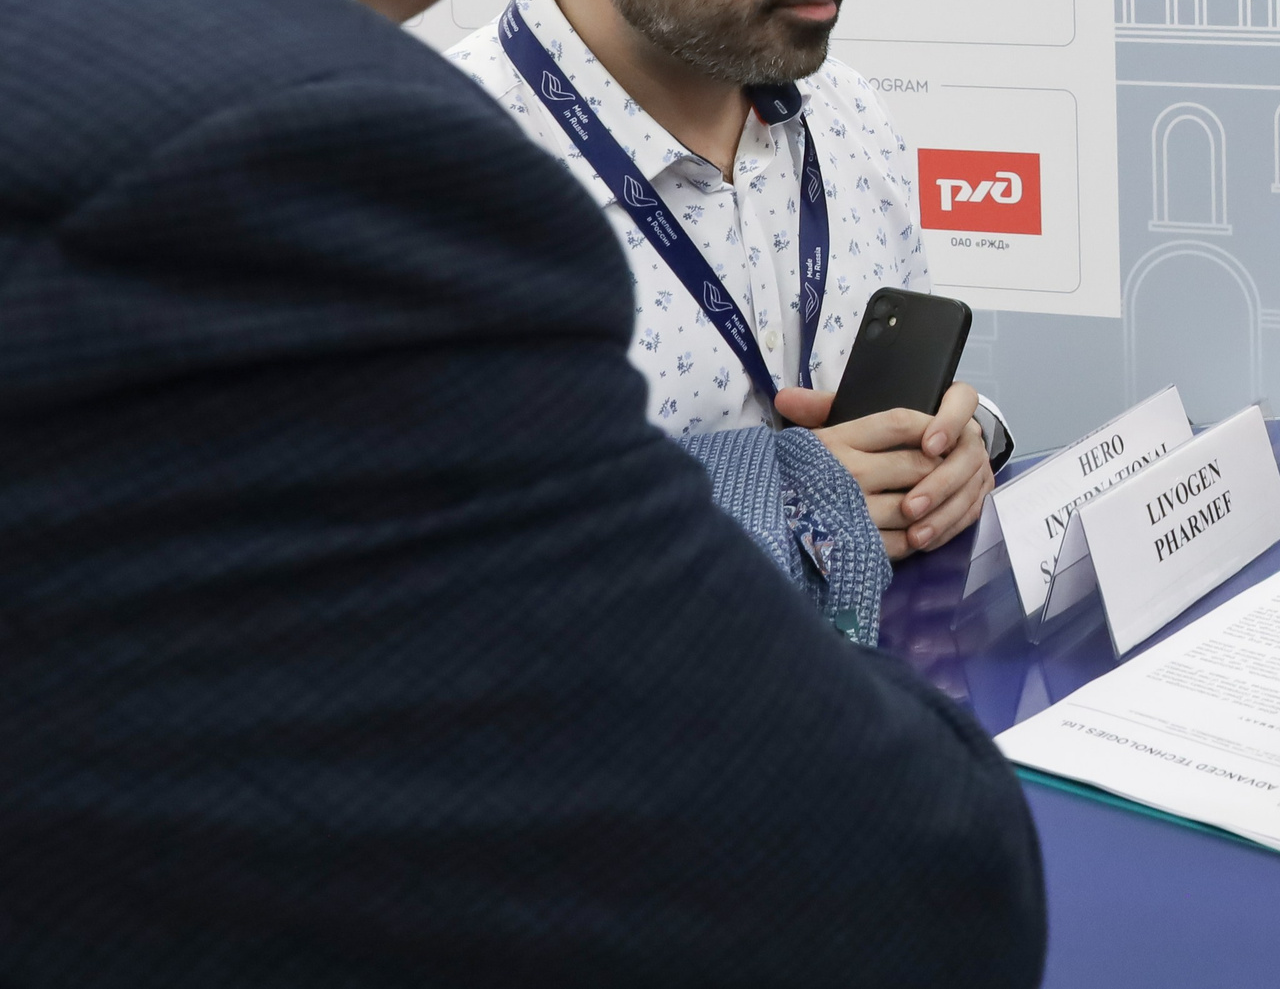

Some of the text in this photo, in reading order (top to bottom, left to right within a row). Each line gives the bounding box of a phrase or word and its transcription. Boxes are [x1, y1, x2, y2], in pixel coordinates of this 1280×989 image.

[563, 110, 589, 141] in Russia
[572, 104, 589, 124] Made
[651, 221, 671, 248] России
[654, 210, 678, 240] Сделано
[950, 236, 972, 248] ОАО
[805, 258, 813, 278] Made
[814, 246, 822, 281] in Russia
[724, 320, 749, 352] in Russia
[731, 314, 746, 334] Made
[1078, 434, 1125, 477] HERO
[1146, 458, 1222, 526] LIVOGEN
[1153, 489, 1232, 564] PHARMEF
[1086, 726, 1193, 767] TECHNOLOGIES
[1195, 762, 1280, 791] ADVANCED
